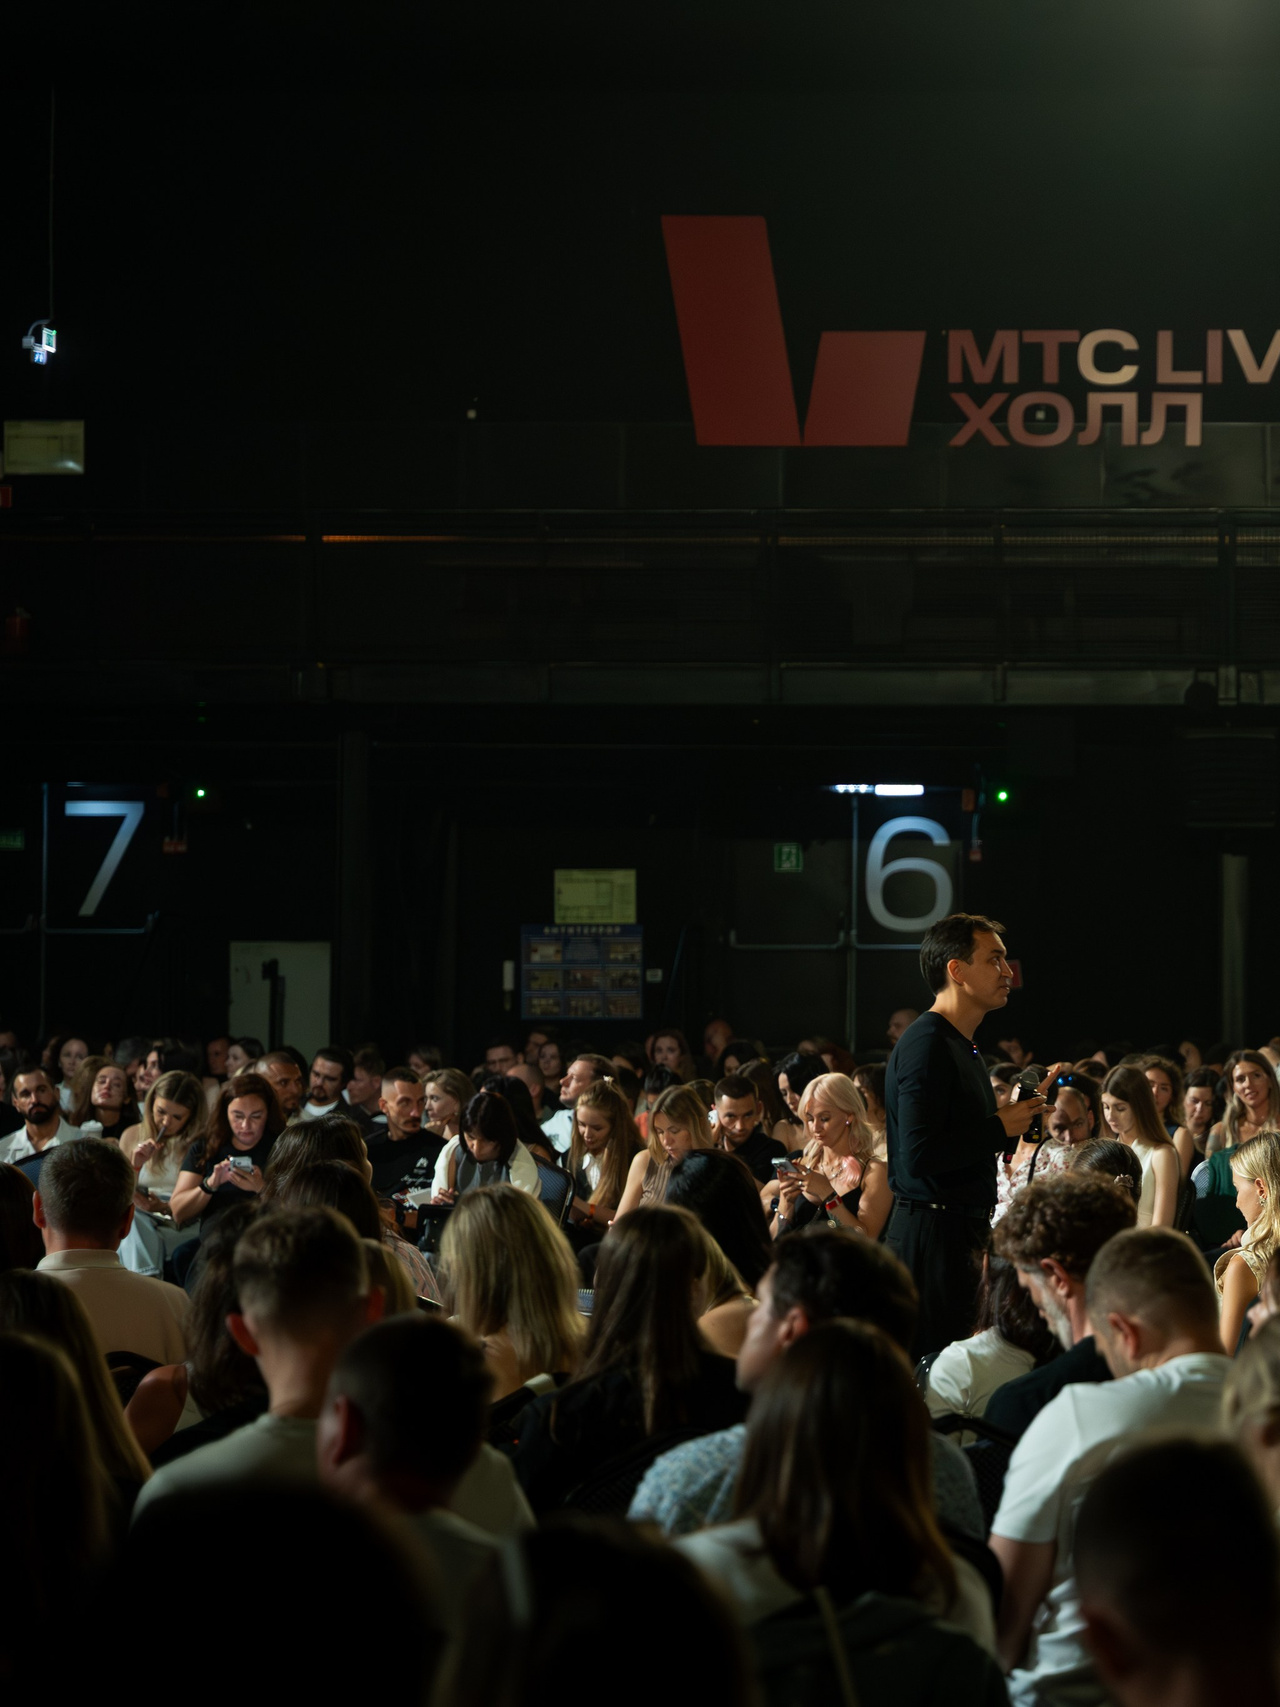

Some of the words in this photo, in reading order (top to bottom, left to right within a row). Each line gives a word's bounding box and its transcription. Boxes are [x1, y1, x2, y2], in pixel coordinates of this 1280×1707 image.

[948, 328, 1139, 385] МТС
[948, 391, 1203, 447] ХОЛЛ
[64, 800, 145, 917] 7
[865, 815, 953, 933] 6
